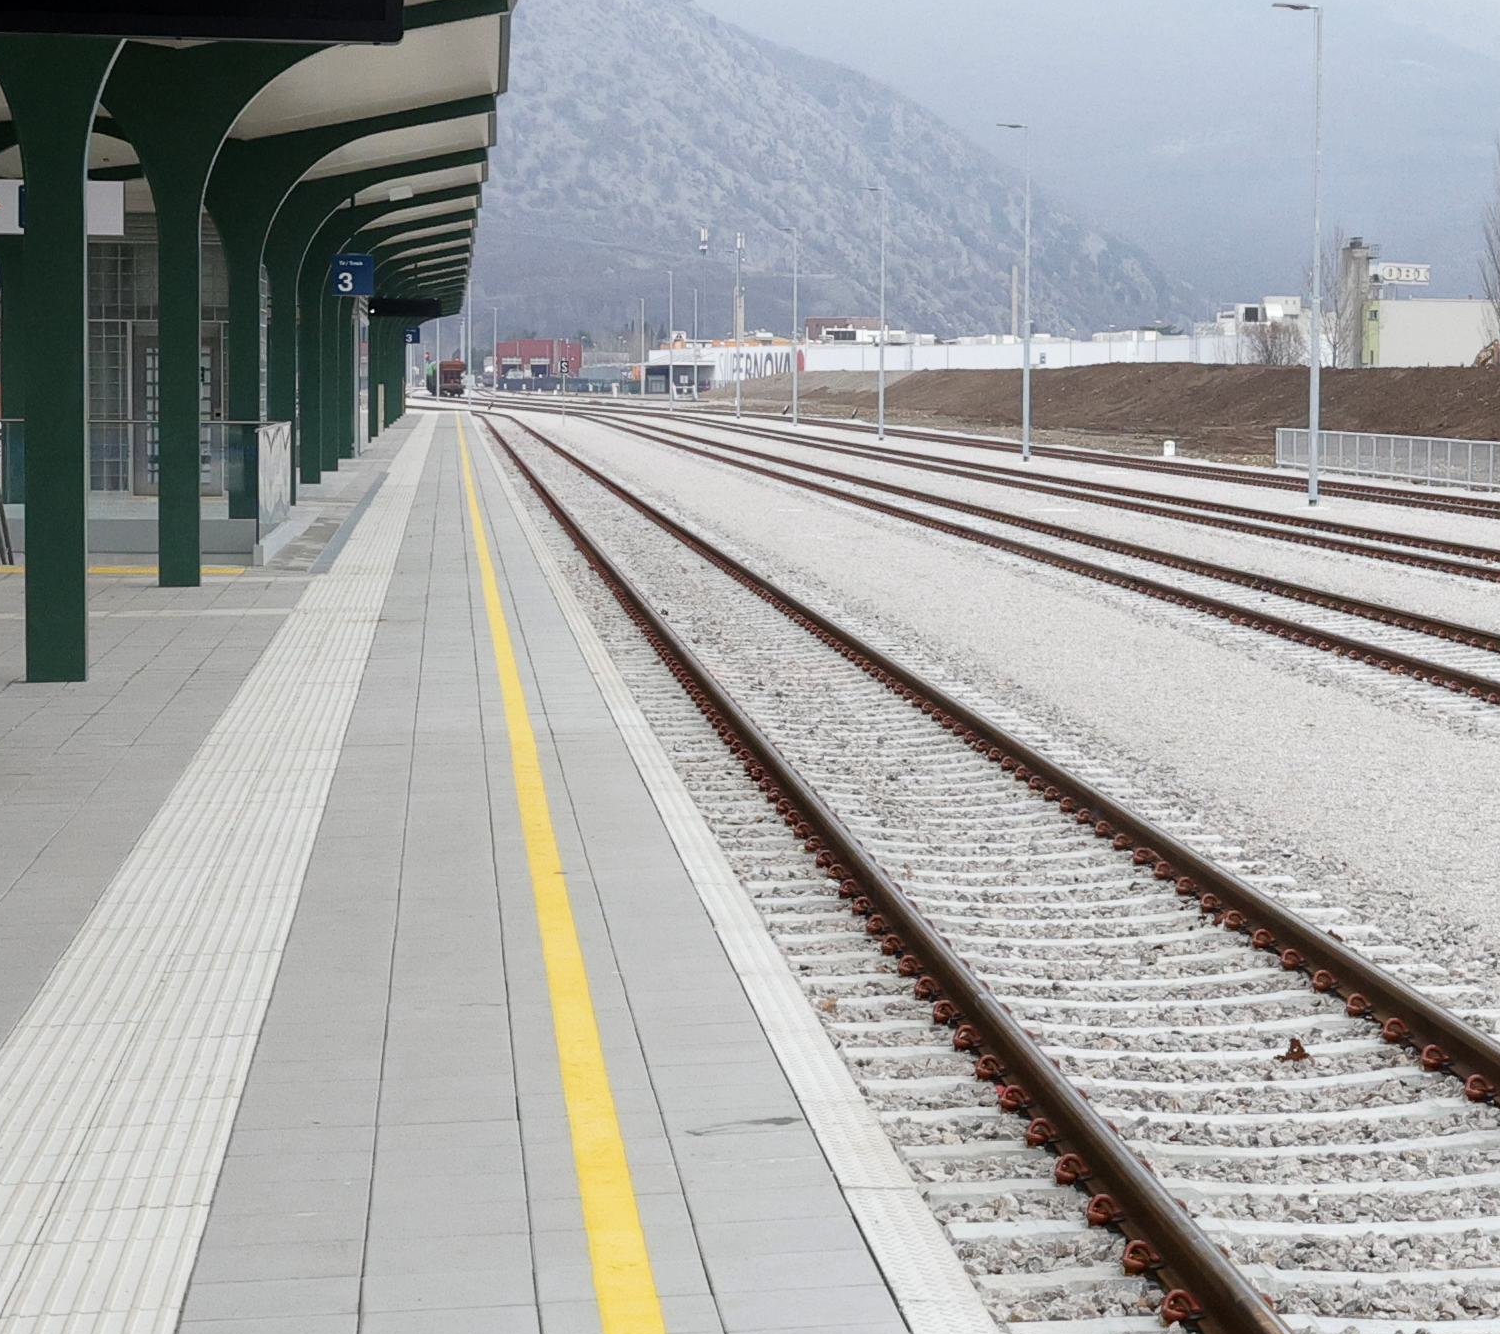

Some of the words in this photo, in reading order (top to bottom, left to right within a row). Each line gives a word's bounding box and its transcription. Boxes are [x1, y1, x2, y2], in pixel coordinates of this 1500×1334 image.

[1382, 266, 1431, 282] OBI
[337, 272, 353, 292] 3
[405, 333, 413, 343] 3
[561, 361, 568, 373] S
